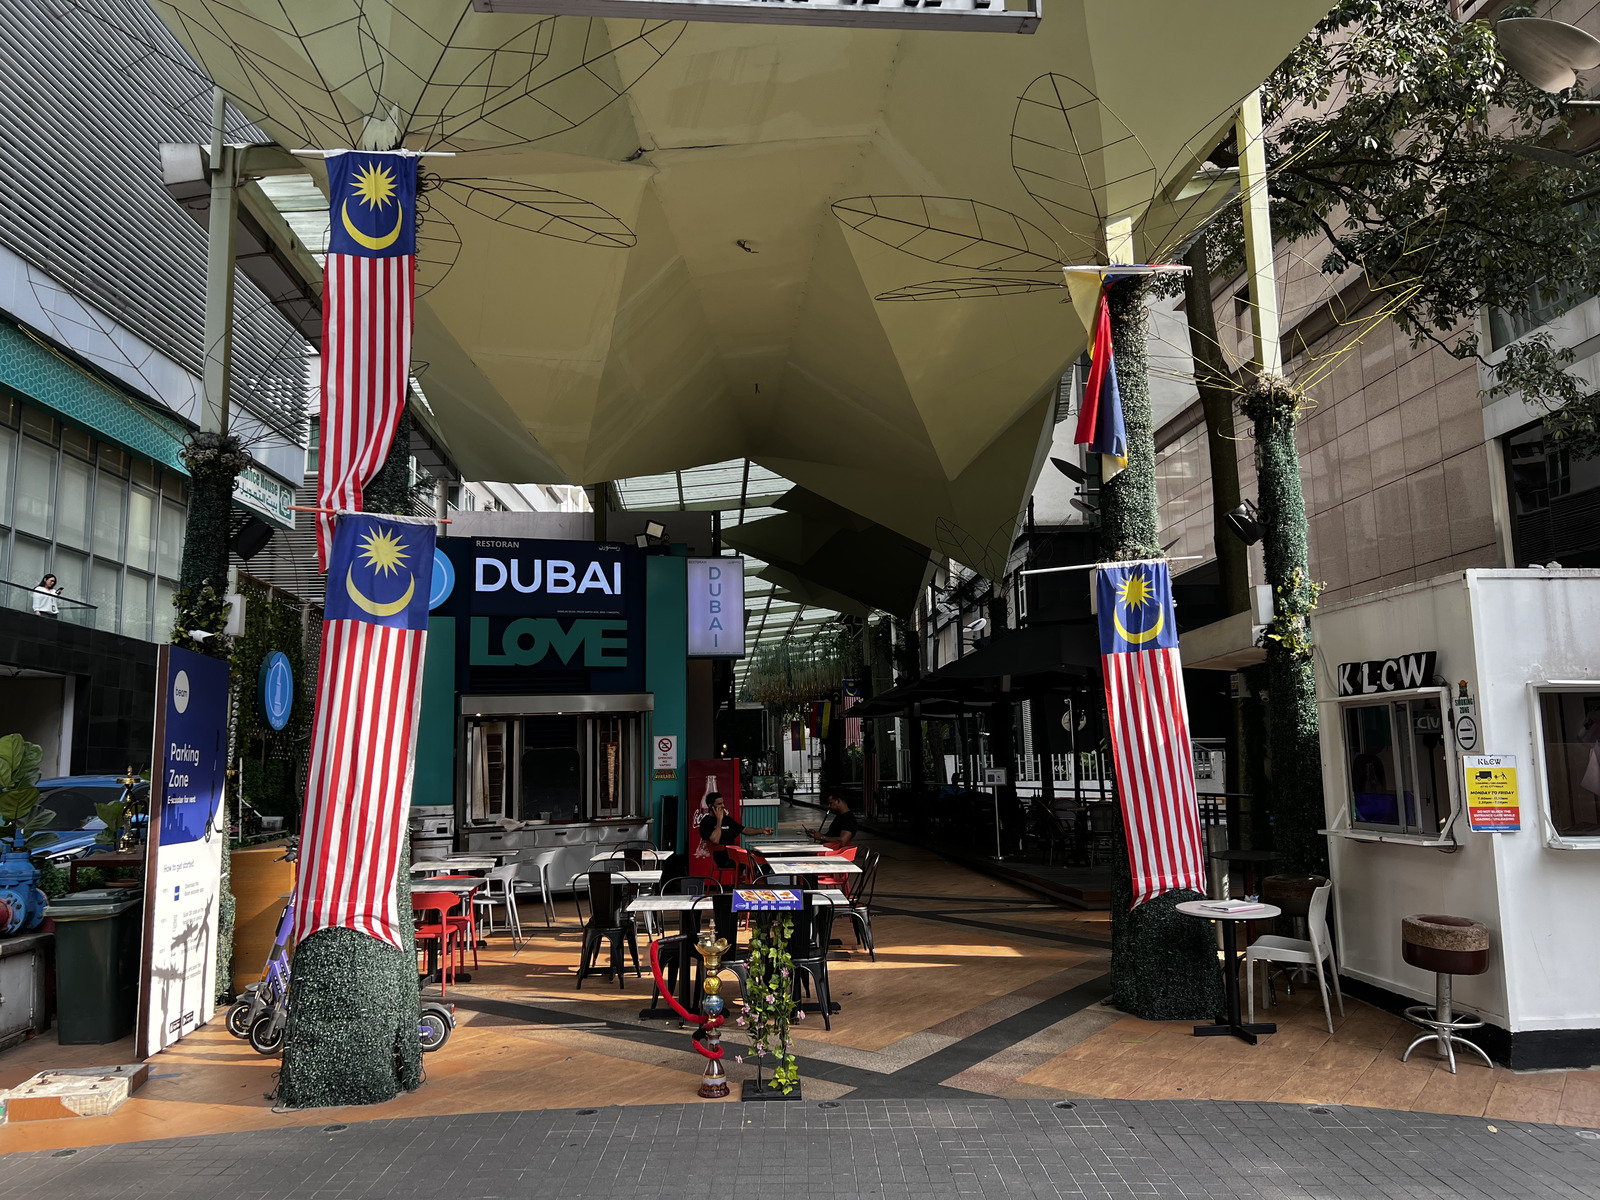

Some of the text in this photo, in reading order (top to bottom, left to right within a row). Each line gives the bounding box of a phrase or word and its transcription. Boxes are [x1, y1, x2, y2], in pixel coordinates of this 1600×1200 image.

[260, 474, 278, 496] House
[476, 540, 520, 548] RESTORAN
[475, 557, 622, 594] DUBAI
[708, 566, 723, 648] DUBAI
[469, 616, 628, 667] LOVE
[175, 687, 188, 698] beam
[1454, 698, 1473, 706] SMOKING
[170, 742, 200, 767] Parking
[168, 769, 189, 788] Zone
[164, 864, 172, 872] How
